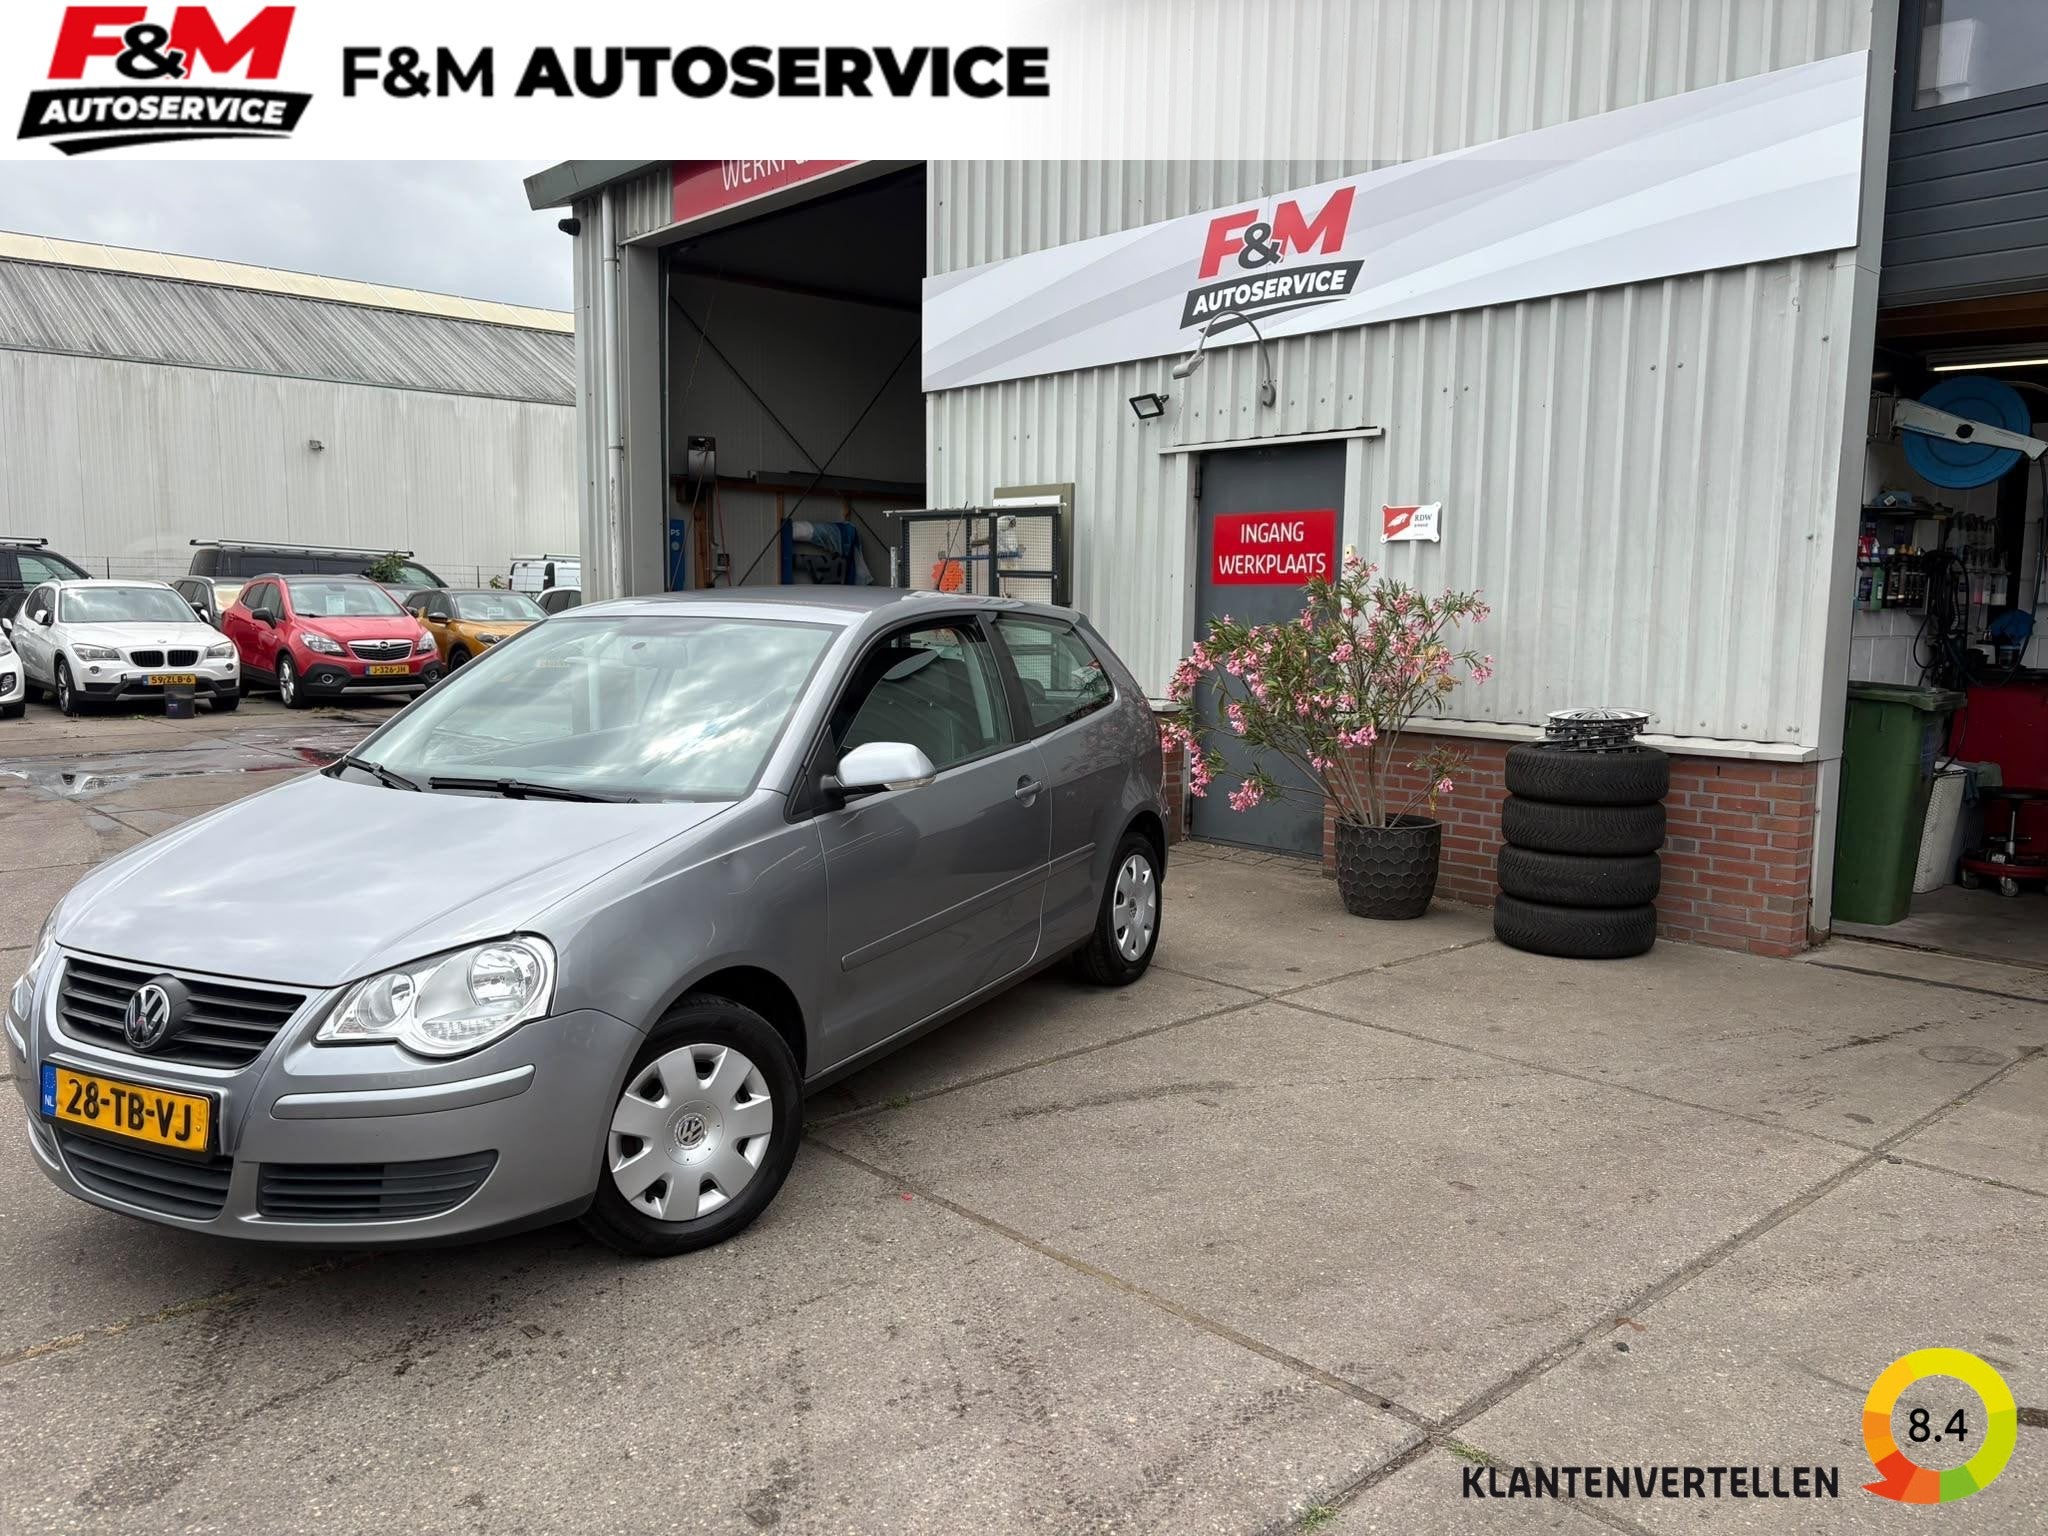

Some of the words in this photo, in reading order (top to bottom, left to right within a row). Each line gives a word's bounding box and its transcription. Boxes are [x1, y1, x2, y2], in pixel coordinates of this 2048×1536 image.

[1198, 186, 1356, 279] F&M
[1192, 269, 1347, 316] AUTOSERVICE
[1240, 521, 1305, 544] INGANG
[1218, 552, 1327, 575] WERKPLAATS
[66, 1078, 191, 1141] 28-TB-VJ
